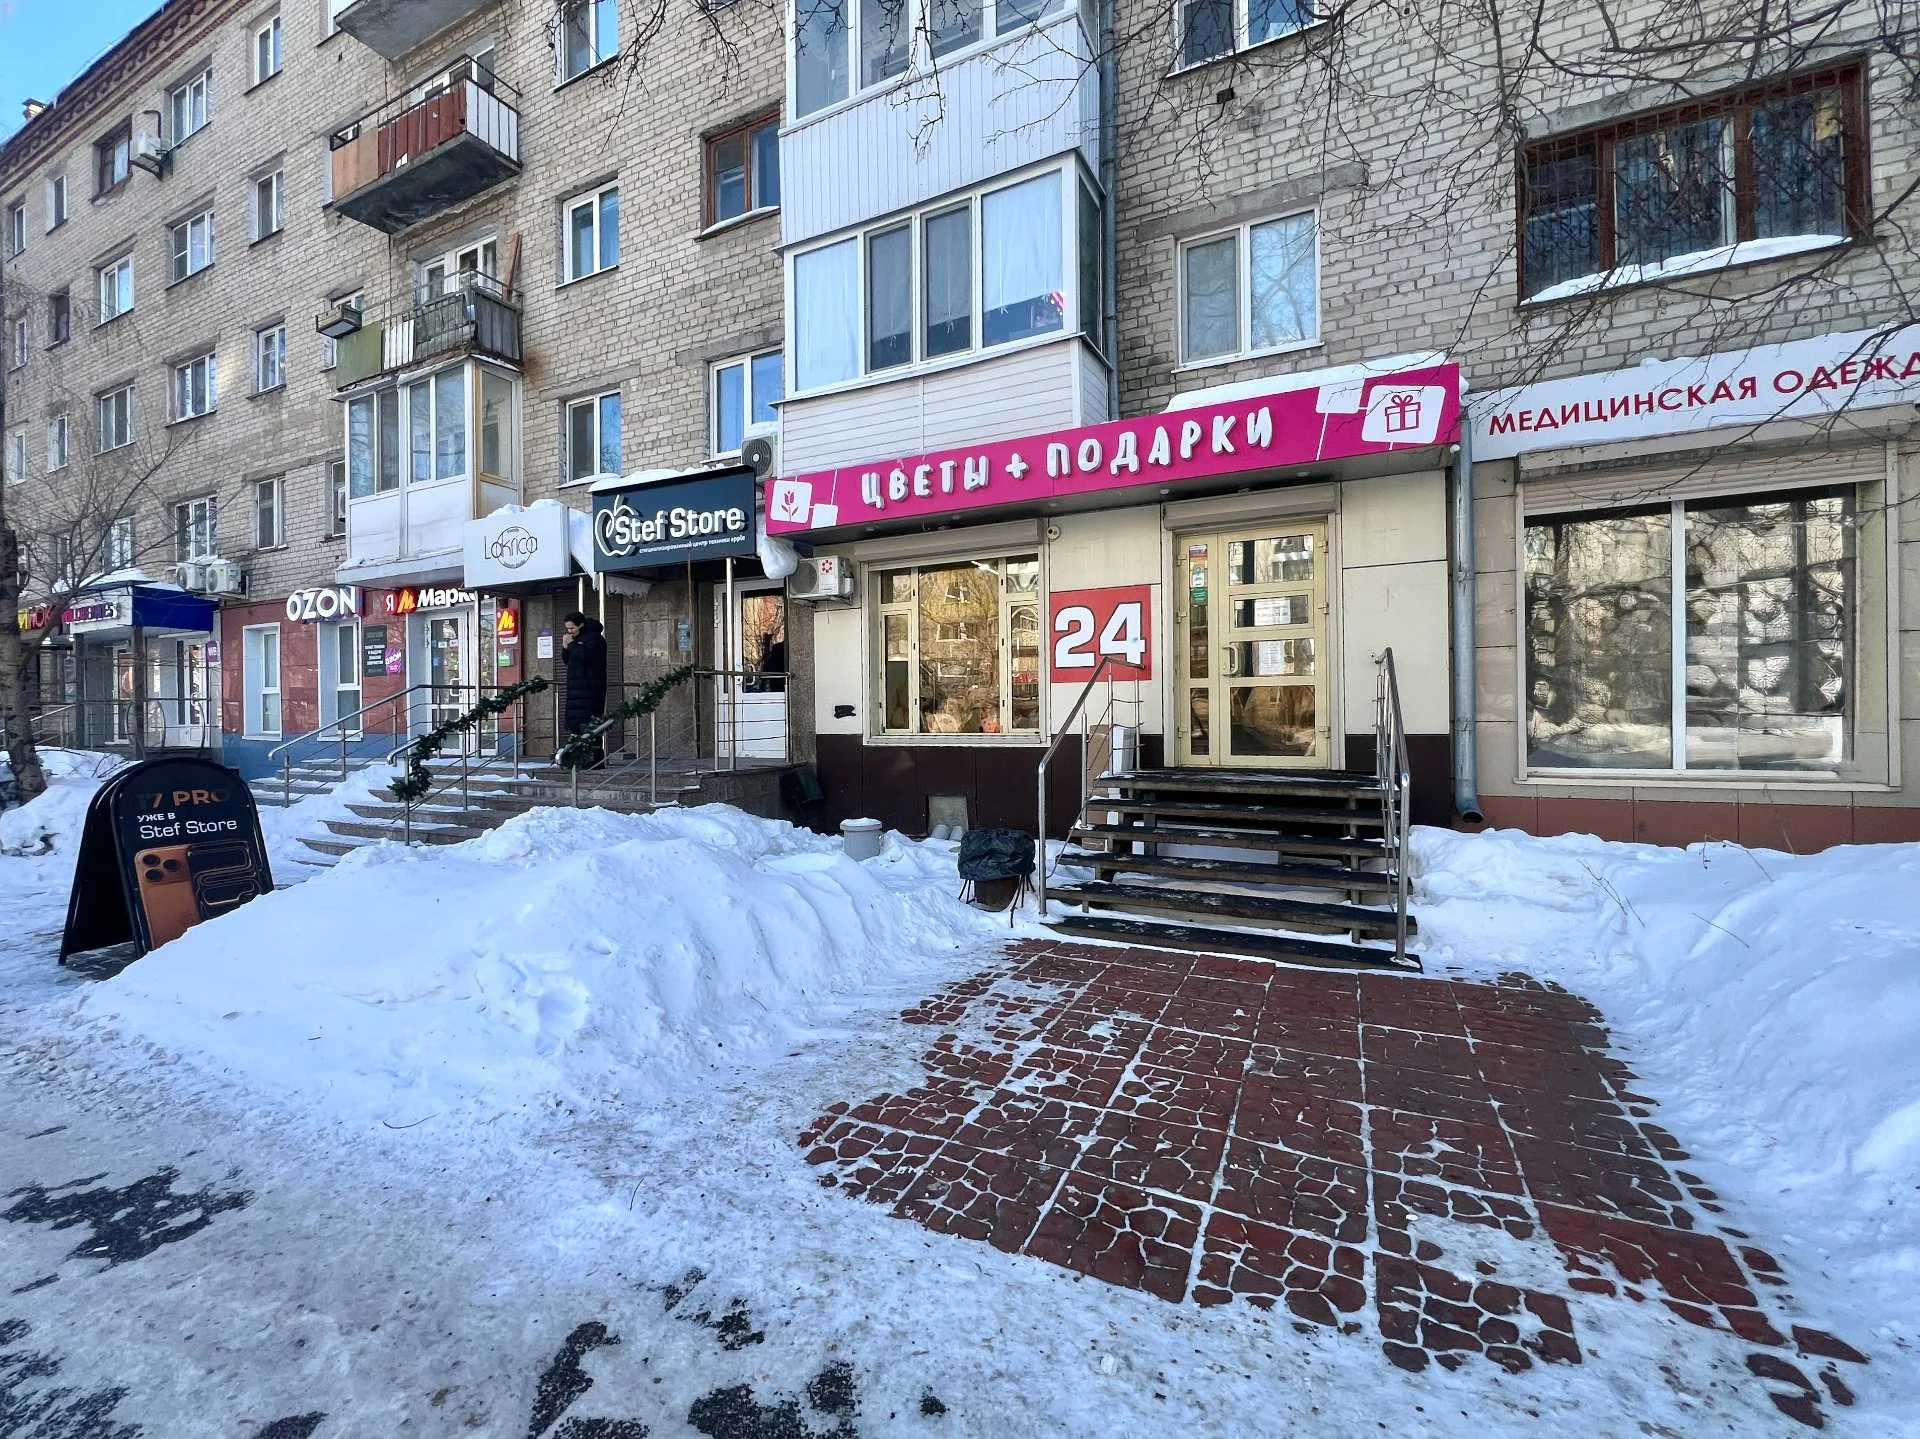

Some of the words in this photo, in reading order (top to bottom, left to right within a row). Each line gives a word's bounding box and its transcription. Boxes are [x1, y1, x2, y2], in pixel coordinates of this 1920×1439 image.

[1489, 376, 1757, 435] МЕДИЦИНСКАЯ
[861, 455, 989, 509] ЦВЕТЫ
[1046, 407, 1273, 478] ПОДАРКИ
[615, 510, 667, 545] Stef
[670, 507, 744, 538] Store
[639, 541, 692, 553] специализированный
[693, 540, 708, 548] центр
[730, 534, 746, 543] apple
[286, 585, 356, 622] OZON
[1053, 601, 1146, 668] 24
[172, 788, 231, 806] PRO
[137, 813, 165, 822] УЖЕ
[167, 812, 176, 820] В
[139, 822, 180, 839] Stef
[185, 820, 238, 834] Store
